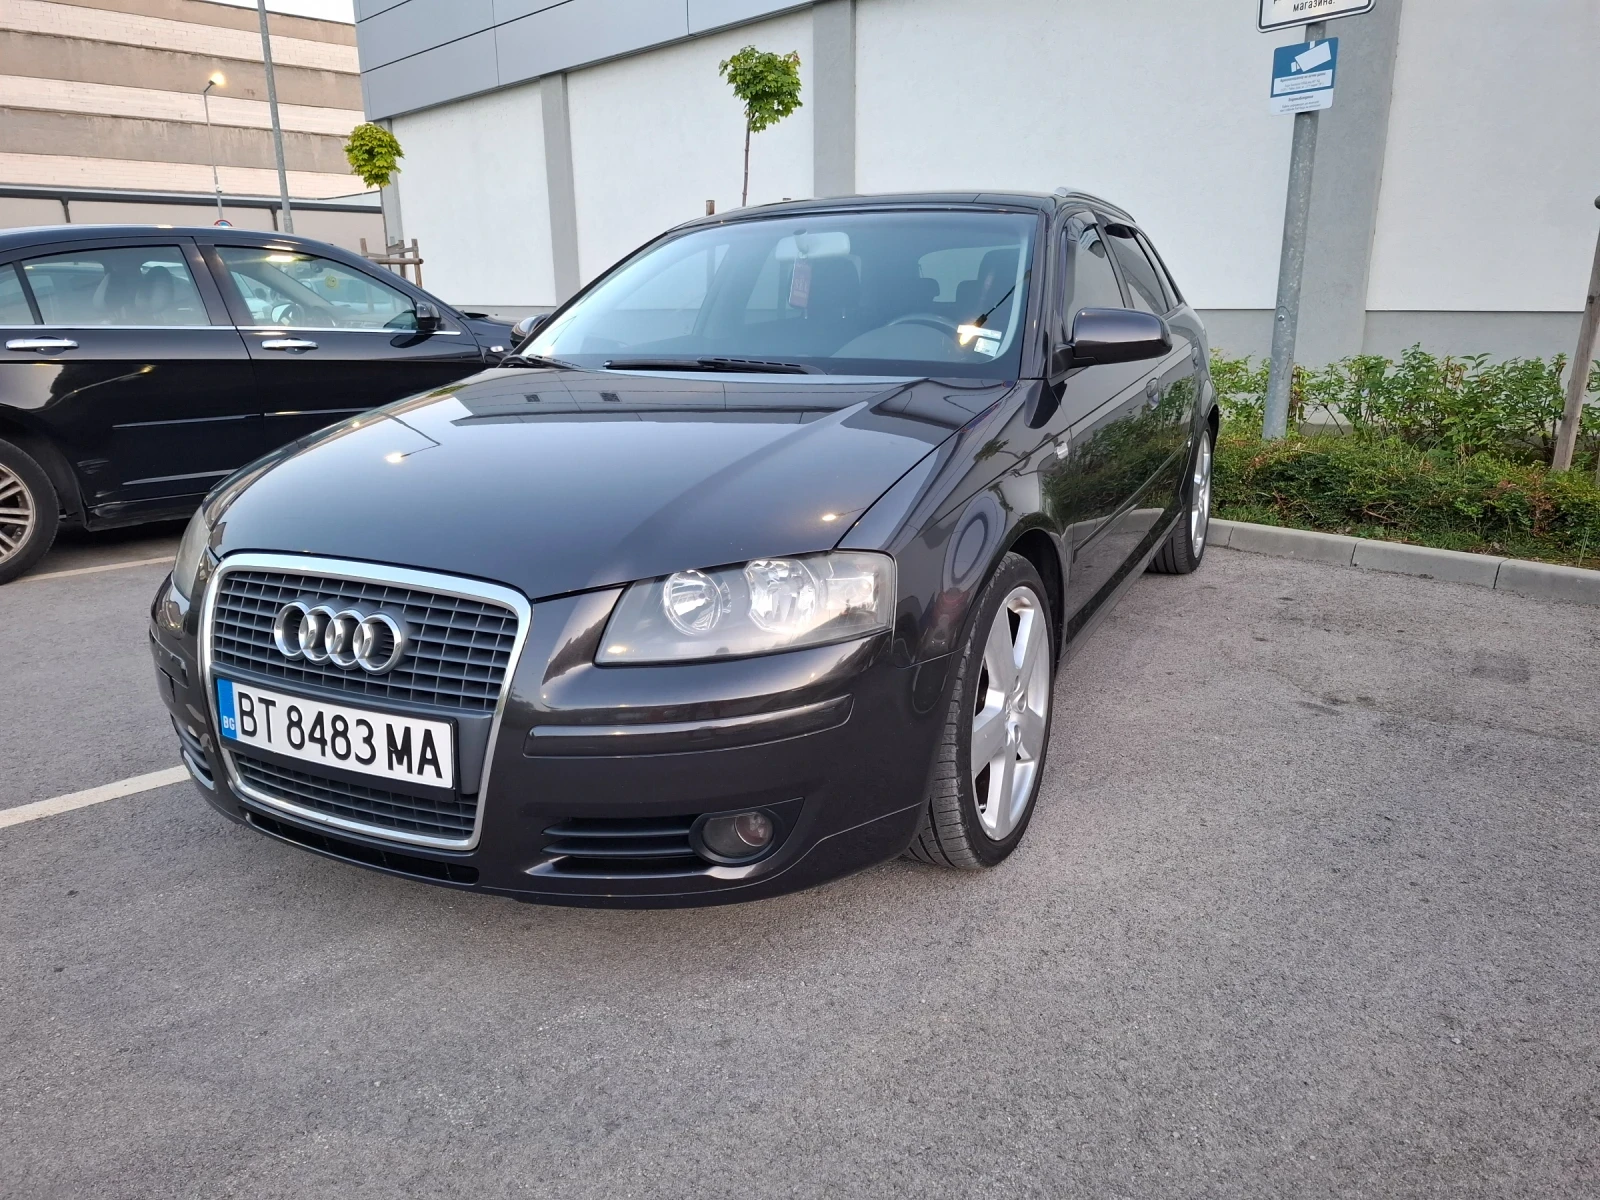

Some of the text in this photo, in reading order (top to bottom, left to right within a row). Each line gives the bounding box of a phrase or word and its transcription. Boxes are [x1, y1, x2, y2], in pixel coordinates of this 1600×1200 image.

[223, 715, 235, 730] BG
[237, 691, 443, 779] BT 8483 MA
